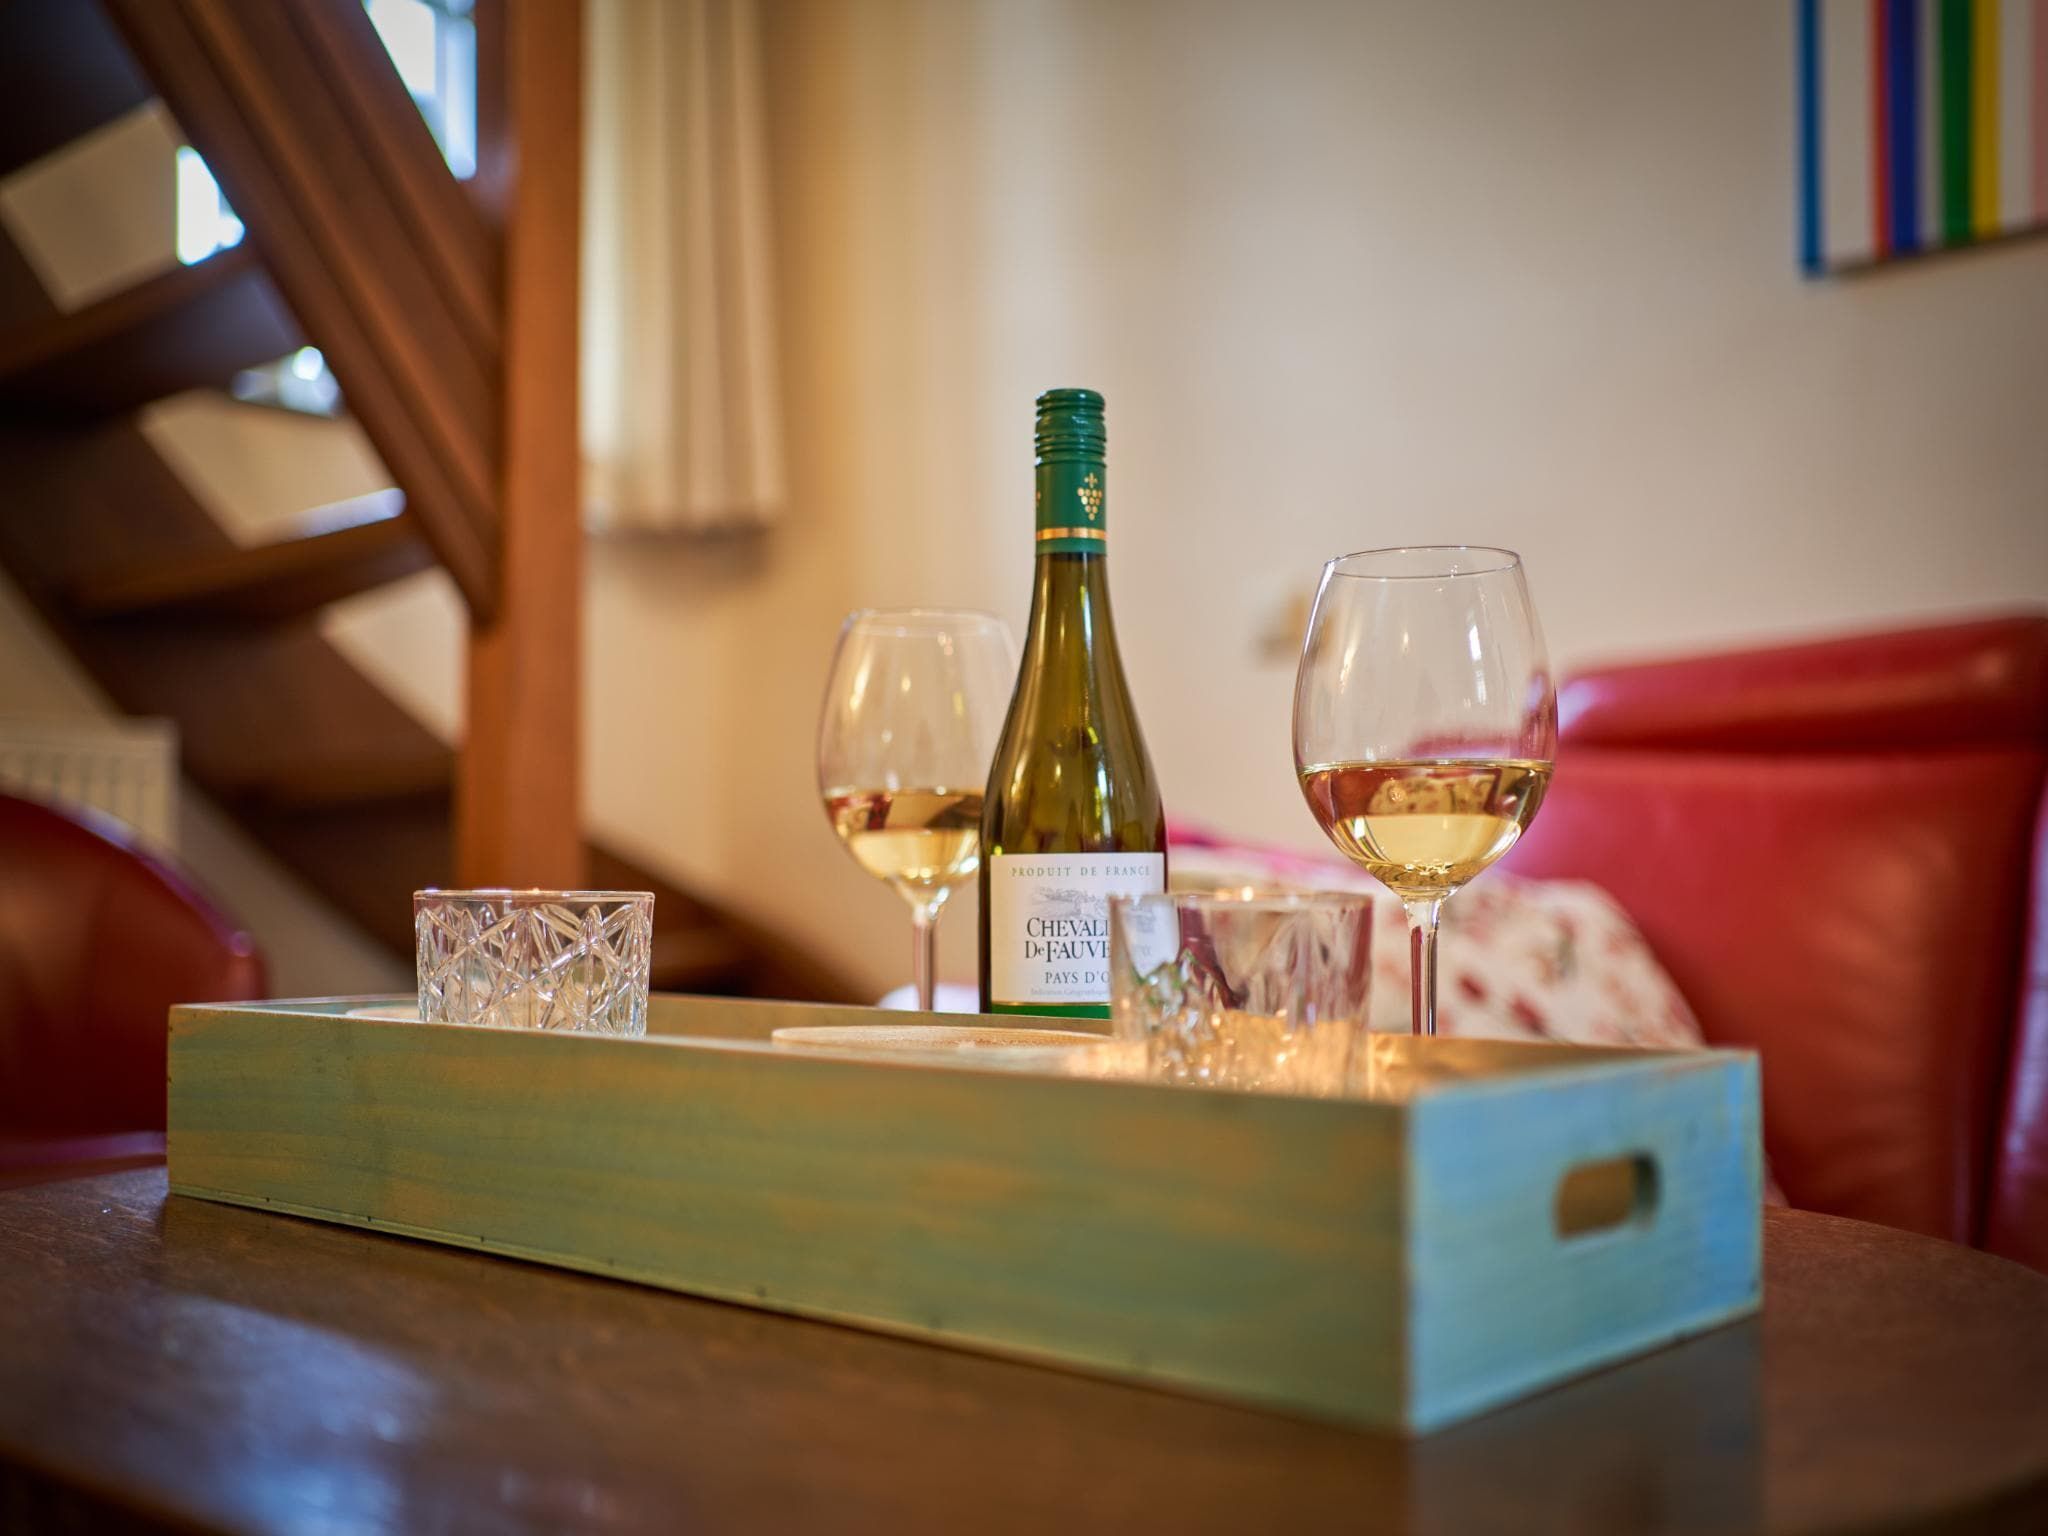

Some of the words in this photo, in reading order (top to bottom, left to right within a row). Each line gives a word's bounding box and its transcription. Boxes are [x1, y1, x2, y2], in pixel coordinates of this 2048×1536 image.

[1011, 866, 1072, 877] PRODUIT
[1080, 866, 1098, 876] DE
[1105, 865, 1151, 876] FRANCE
[1026, 916, 1109, 938] CHEVALI
[1024, 940, 1110, 963] DeFAUVE
[1044, 971, 1079, 984] PAYS
[1084, 971, 1110, 984] D'O
